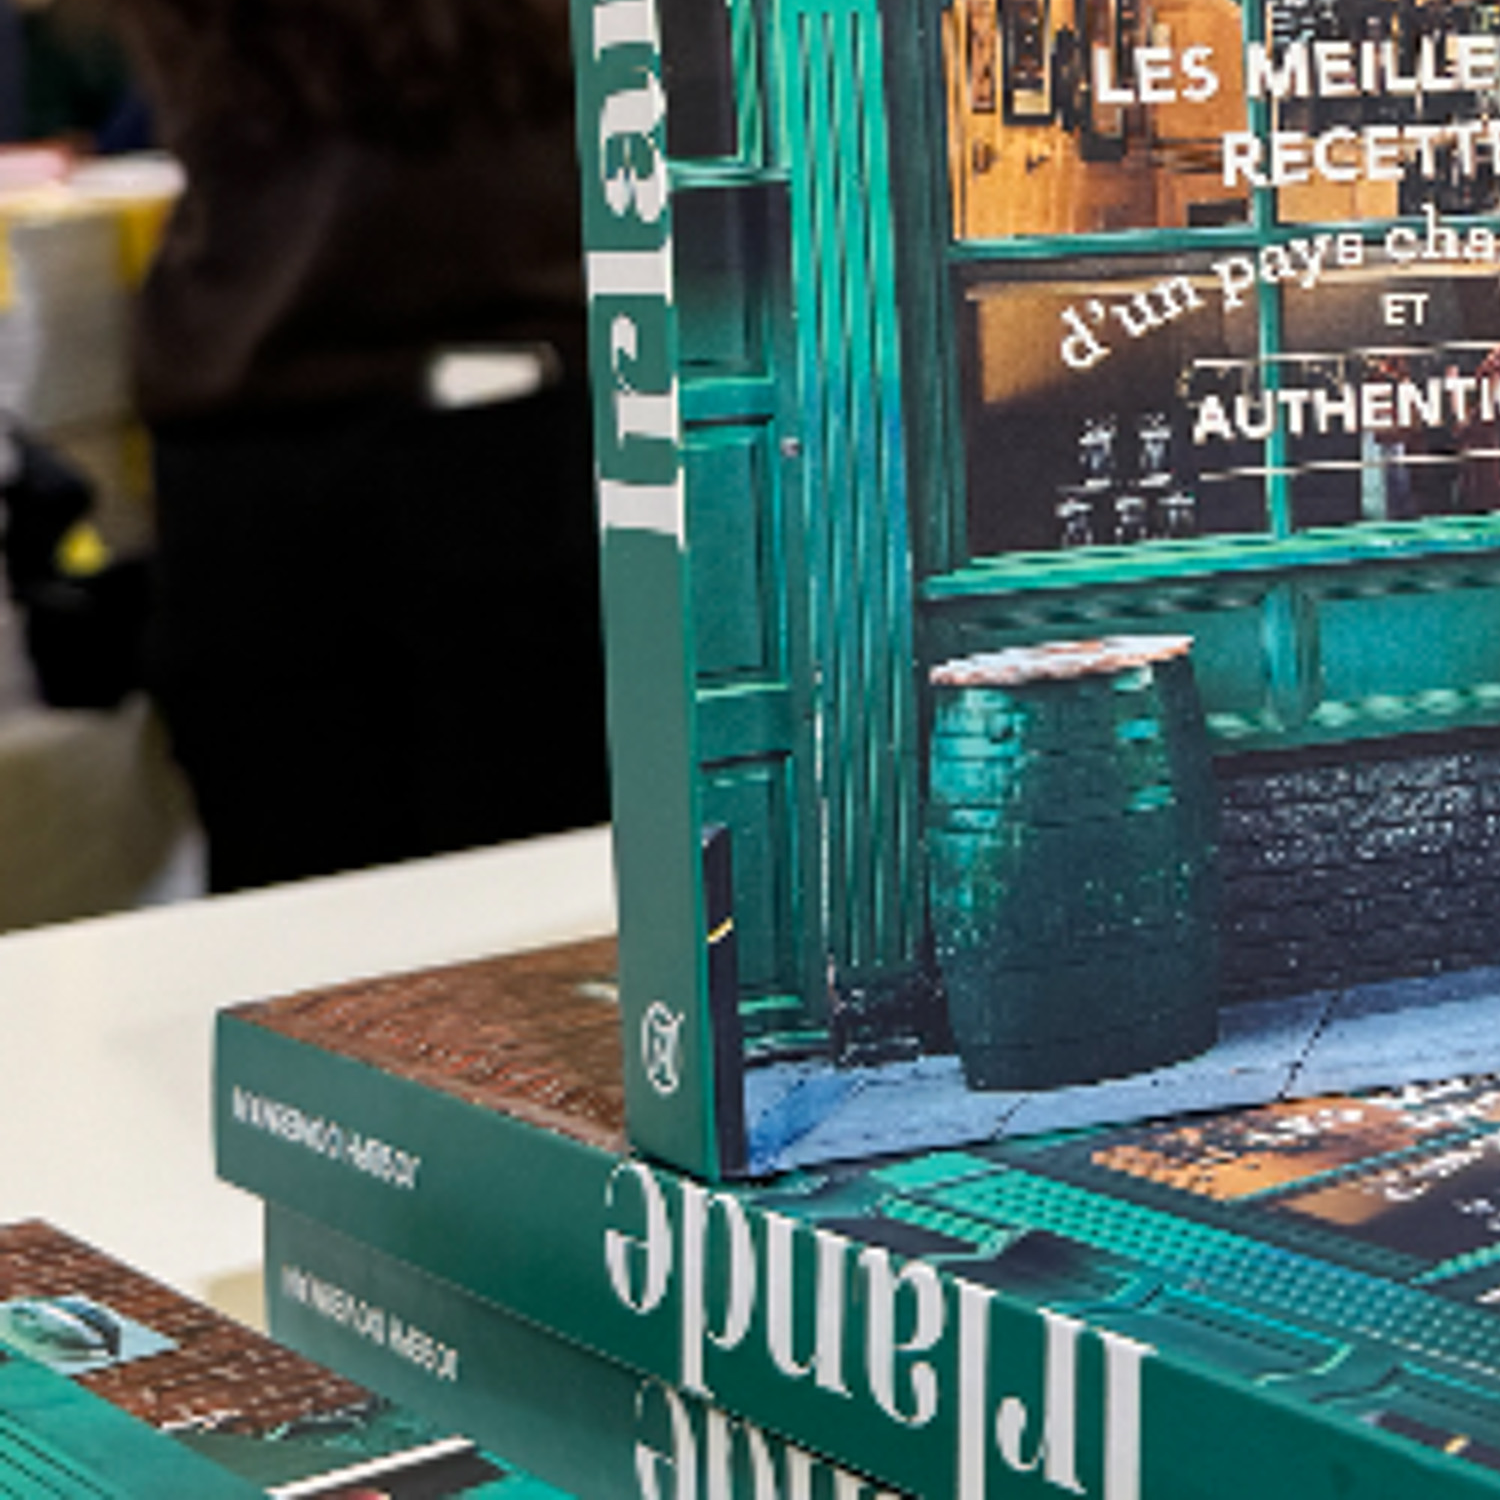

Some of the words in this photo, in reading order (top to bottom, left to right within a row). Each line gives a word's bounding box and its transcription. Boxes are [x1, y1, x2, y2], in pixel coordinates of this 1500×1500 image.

[1091, 45, 1220, 105] LES
[1059, 269, 1206, 370] d'un
[1212, 226, 1365, 308] pays
[1384, 292, 1429, 326] ET
[604, 1160, 1158, 1500] Irlande
